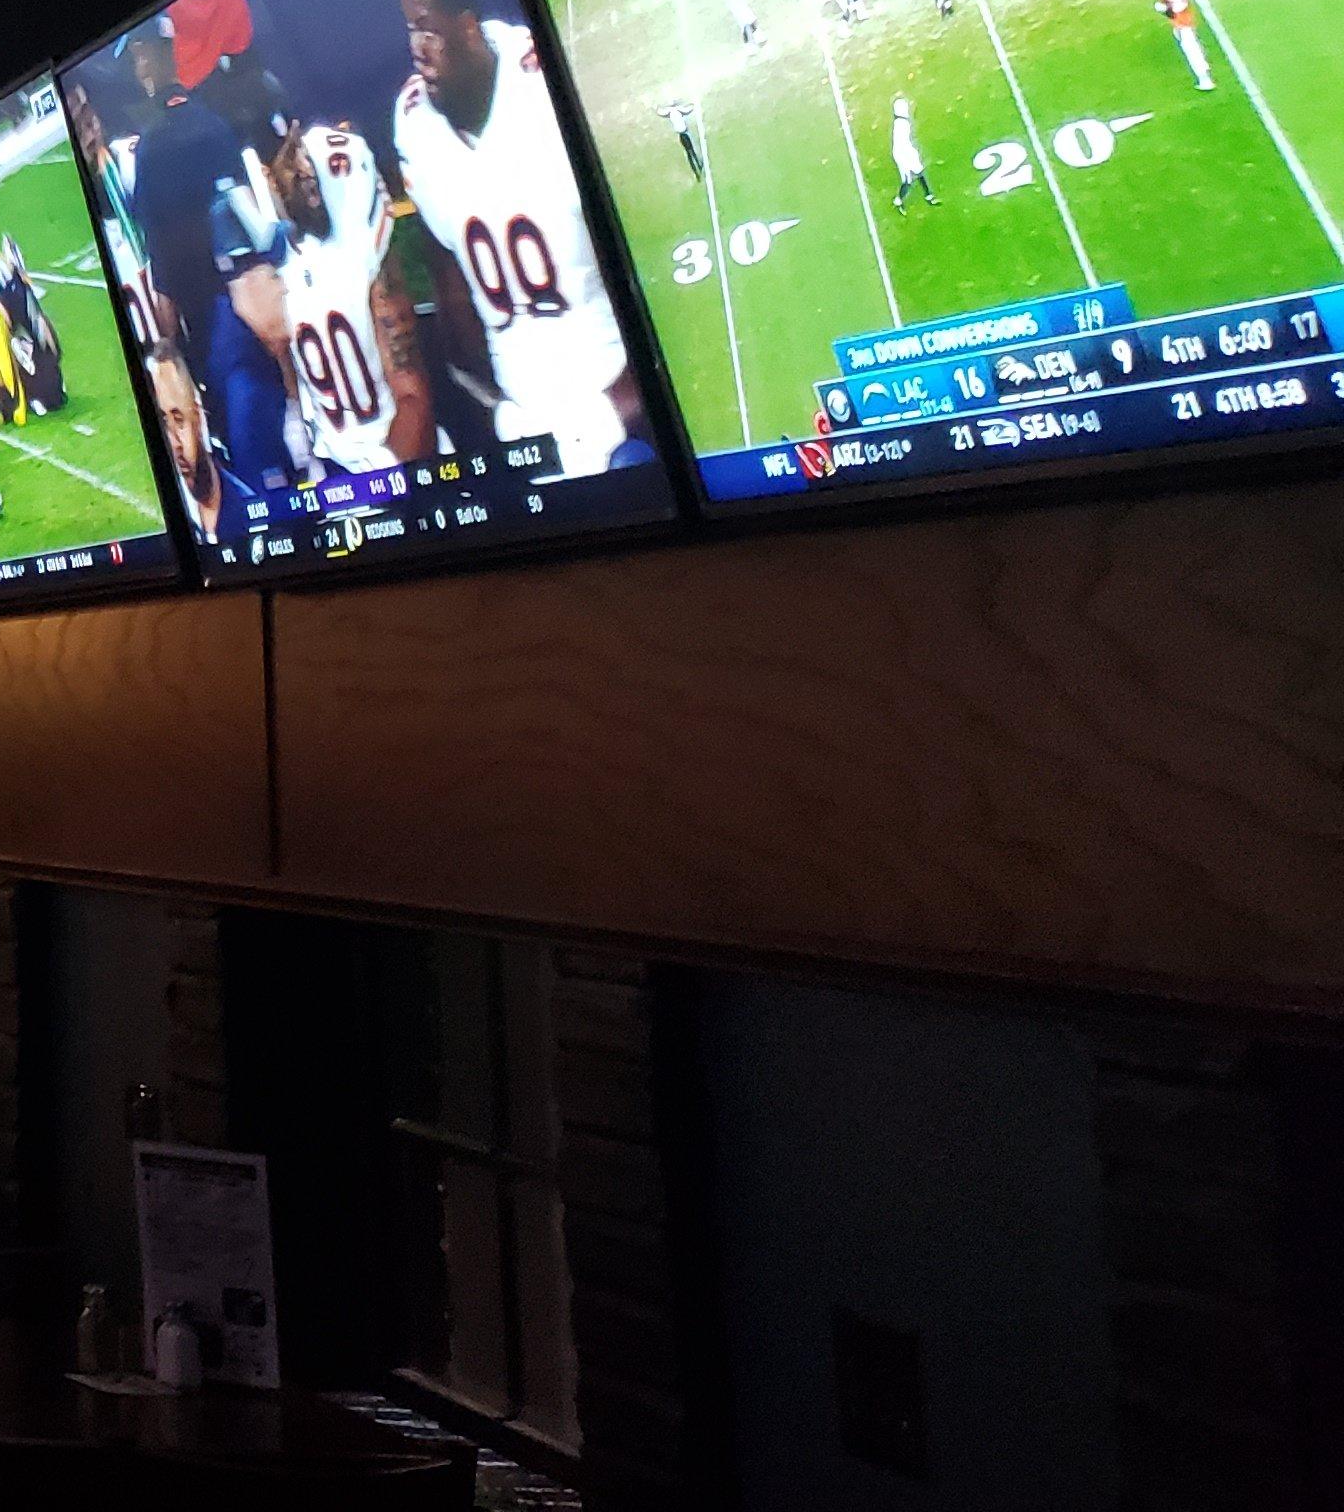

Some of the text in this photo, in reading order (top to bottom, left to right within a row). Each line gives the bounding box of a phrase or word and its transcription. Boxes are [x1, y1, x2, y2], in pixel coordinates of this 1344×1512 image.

[973, 118, 1116, 197] 20
[672, 220, 771, 285] 30
[296, 310, 380, 433] 90
[873, 335, 923, 363] DOWN
[922, 311, 1039, 354] CONVERSIONS
[892, 376, 928, 404] LAC
[953, 366, 986, 400] 16
[1033, 349, 1078, 379] DEN
[1112, 339, 1133, 374] 9
[1162, 335, 1207, 365] 4TH
[1290, 311, 1320, 340] 17
[762, 452, 797, 478] NFL
[832, 441, 866, 468] ARZ
[950, 425, 975, 450] 21
[1019, 412, 1063, 440] SEA
[1171, 391, 1203, 420] 21
[1216, 385, 1259, 414] 4TH
[303, 490, 320, 513] 21
[323, 484, 355, 504] VIKINGS
[388, 471, 407, 496] 10
[470, 456, 487, 476] 15
[532, 445, 542, 464] 2
[325, 527, 340, 548] 24
[365, 518, 405, 540] REDSKINS
[435, 509, 446, 530] 0
[527, 494, 543, 514] 50
